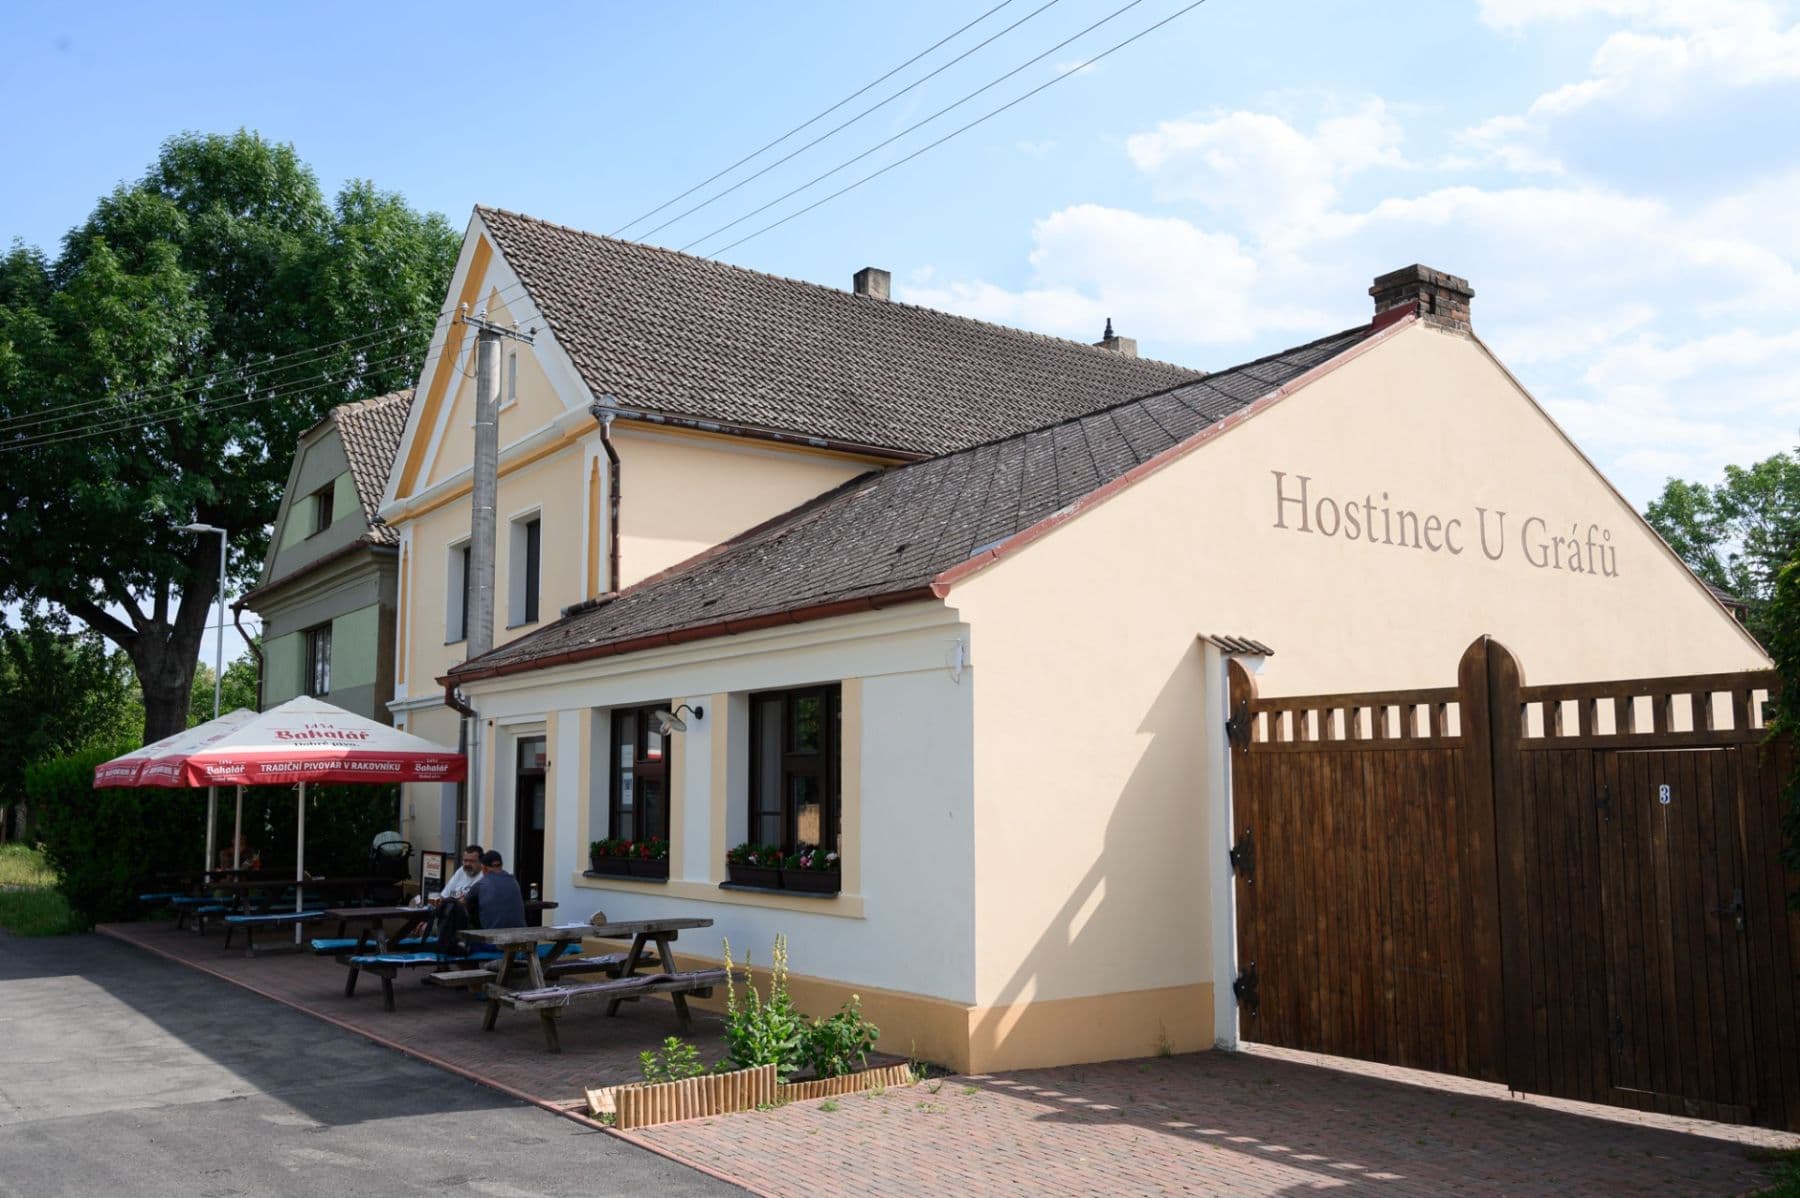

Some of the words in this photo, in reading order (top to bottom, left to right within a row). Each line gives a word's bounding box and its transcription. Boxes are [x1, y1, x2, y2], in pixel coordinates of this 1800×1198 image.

[1270, 470, 1465, 556] Hostinec
[1475, 506, 1507, 562] U
[1520, 517, 1620, 577] Gráfů
[274, 730, 370, 740] Bakalář
[260, 762, 302, 772] TRADIČNÍ
[303, 761, 342, 770] PIVOVAR
[351, 761, 401, 771] RAKOVNÍKU
[1661, 787, 1668, 803] 3
